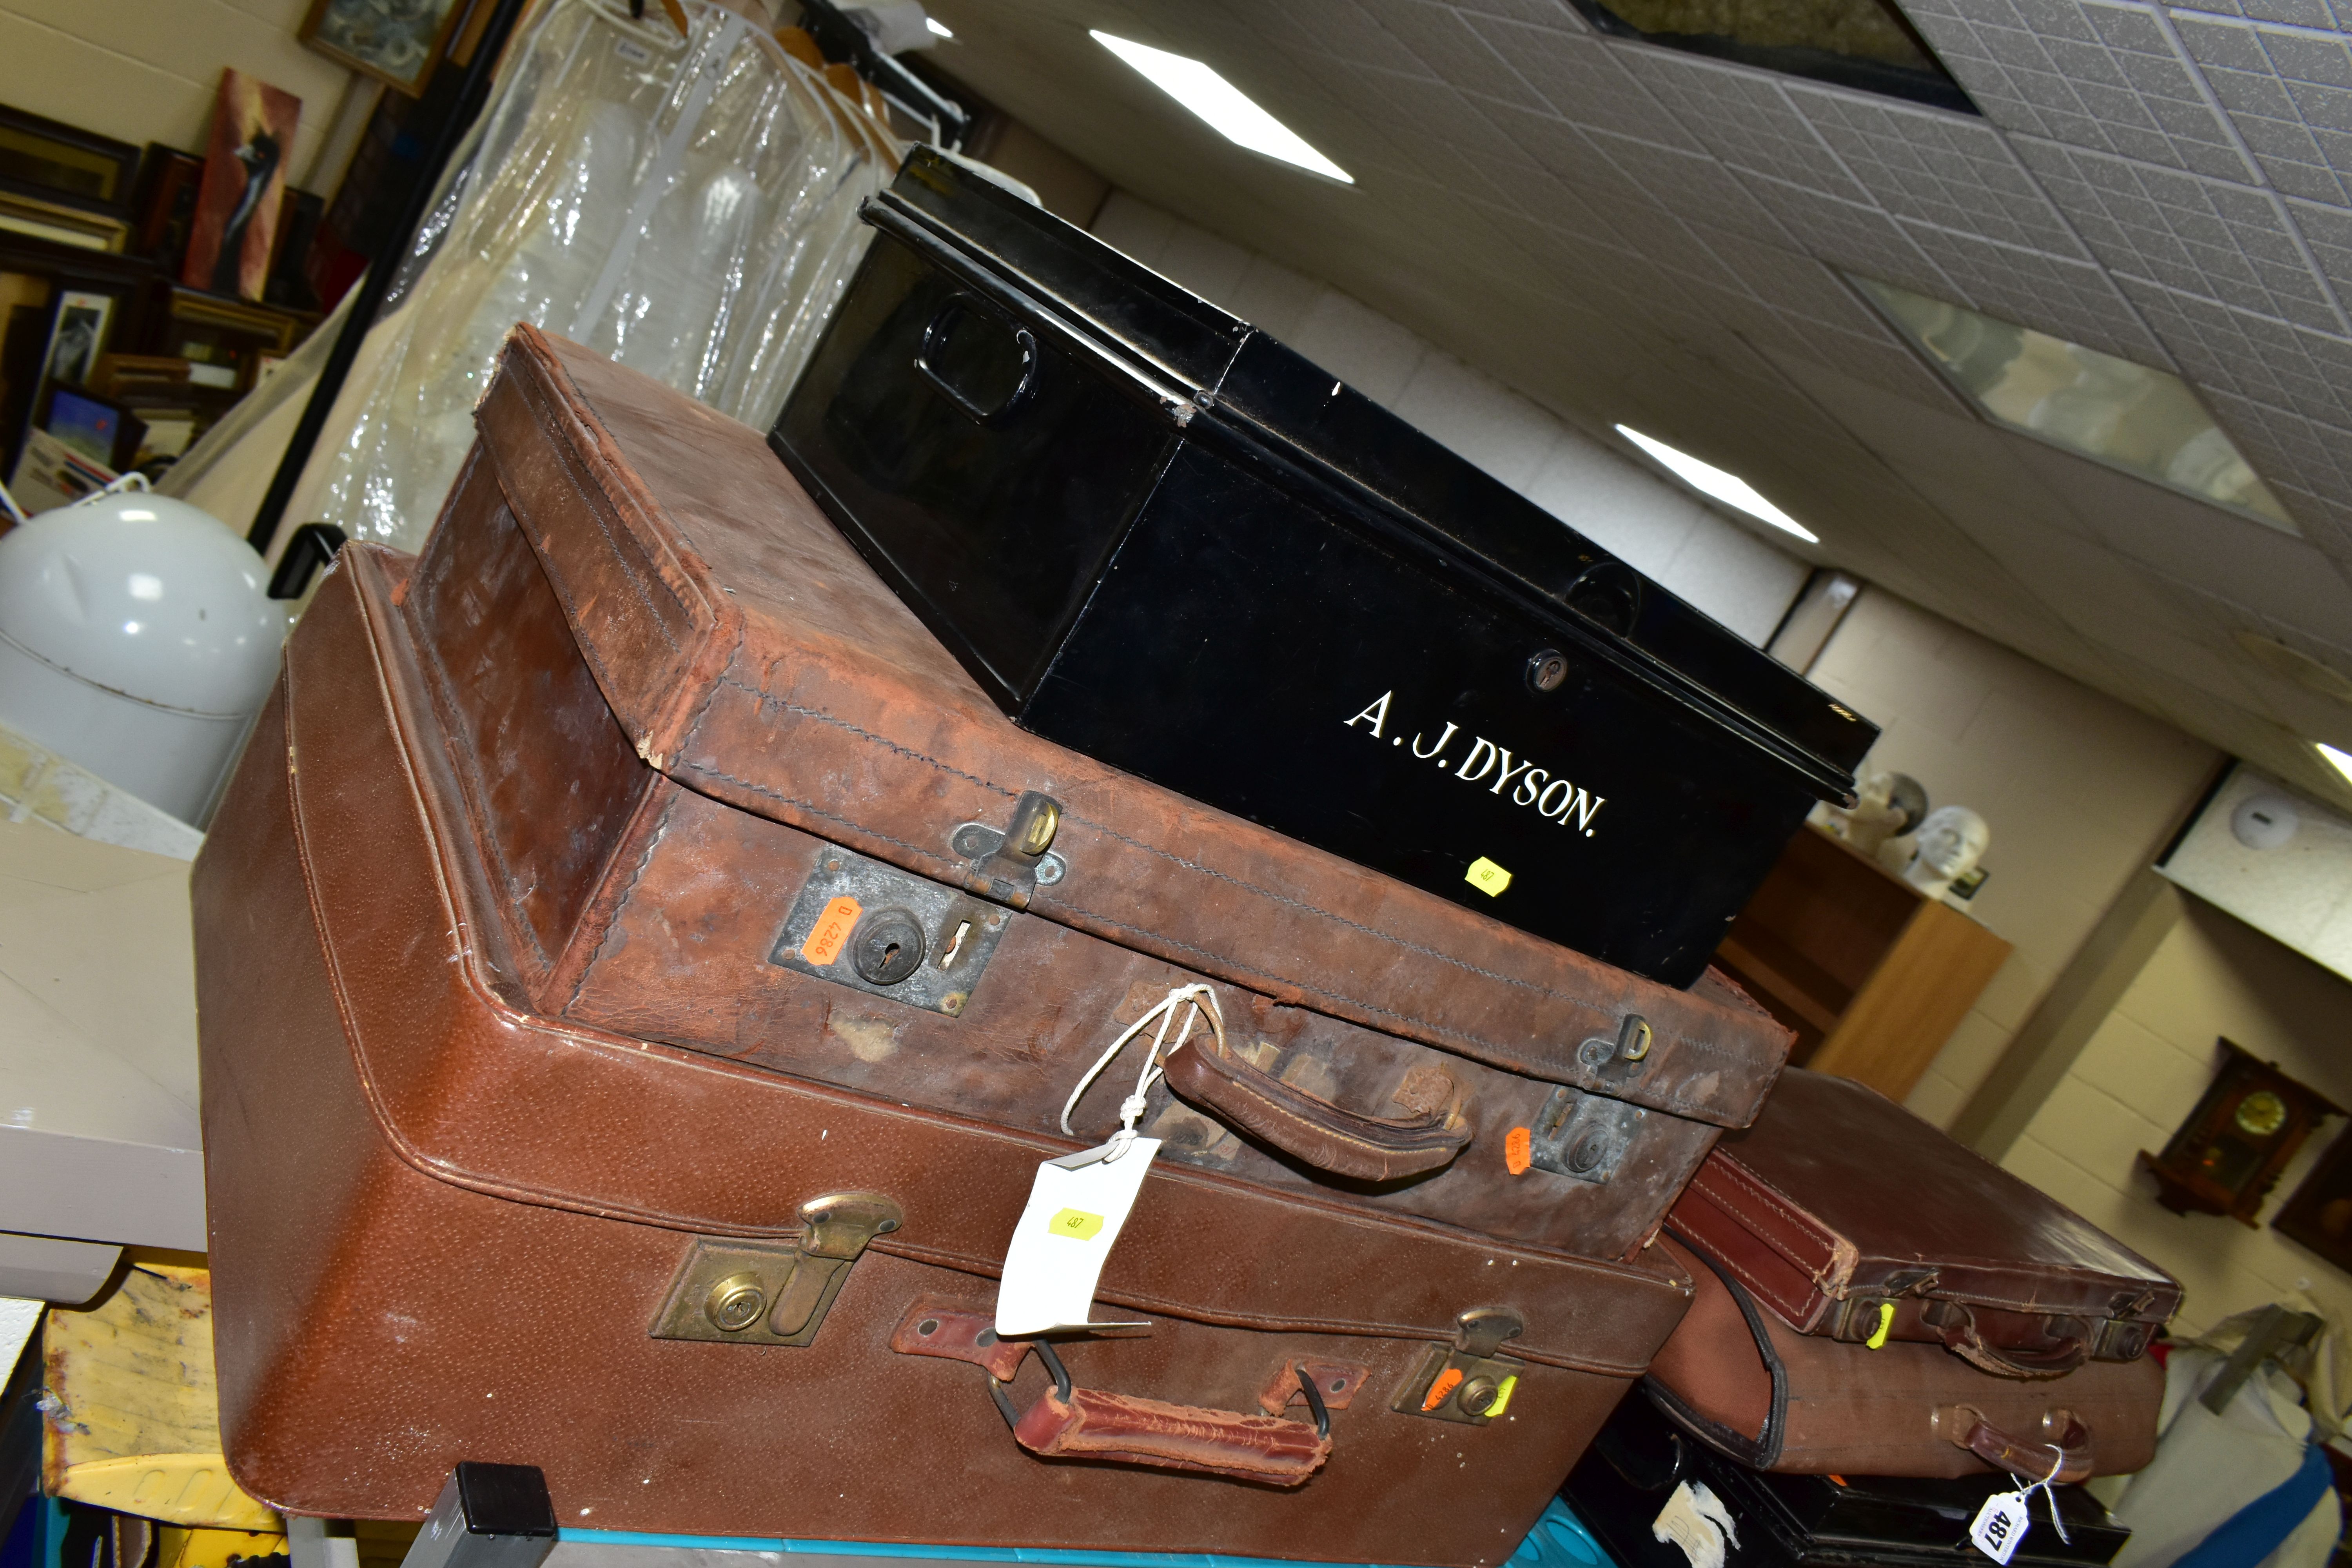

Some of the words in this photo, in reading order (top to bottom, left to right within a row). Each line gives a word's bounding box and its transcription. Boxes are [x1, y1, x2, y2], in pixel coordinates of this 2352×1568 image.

[1481, 869, 1494, 881] 487
[838, 906, 852, 916] D
[815, 922, 841, 956] 4286
[1512, 1134, 1520, 1155] 4286
[1067, 1216, 1084, 1228] 487
[1435, 1383, 1454, 1401] 4286
[1984, 1510, 2011, 1552] 487
[2011, 1515, 2023, 1537] RICHARD
[1999, 1536, 2014, 1561] WINTERTON
